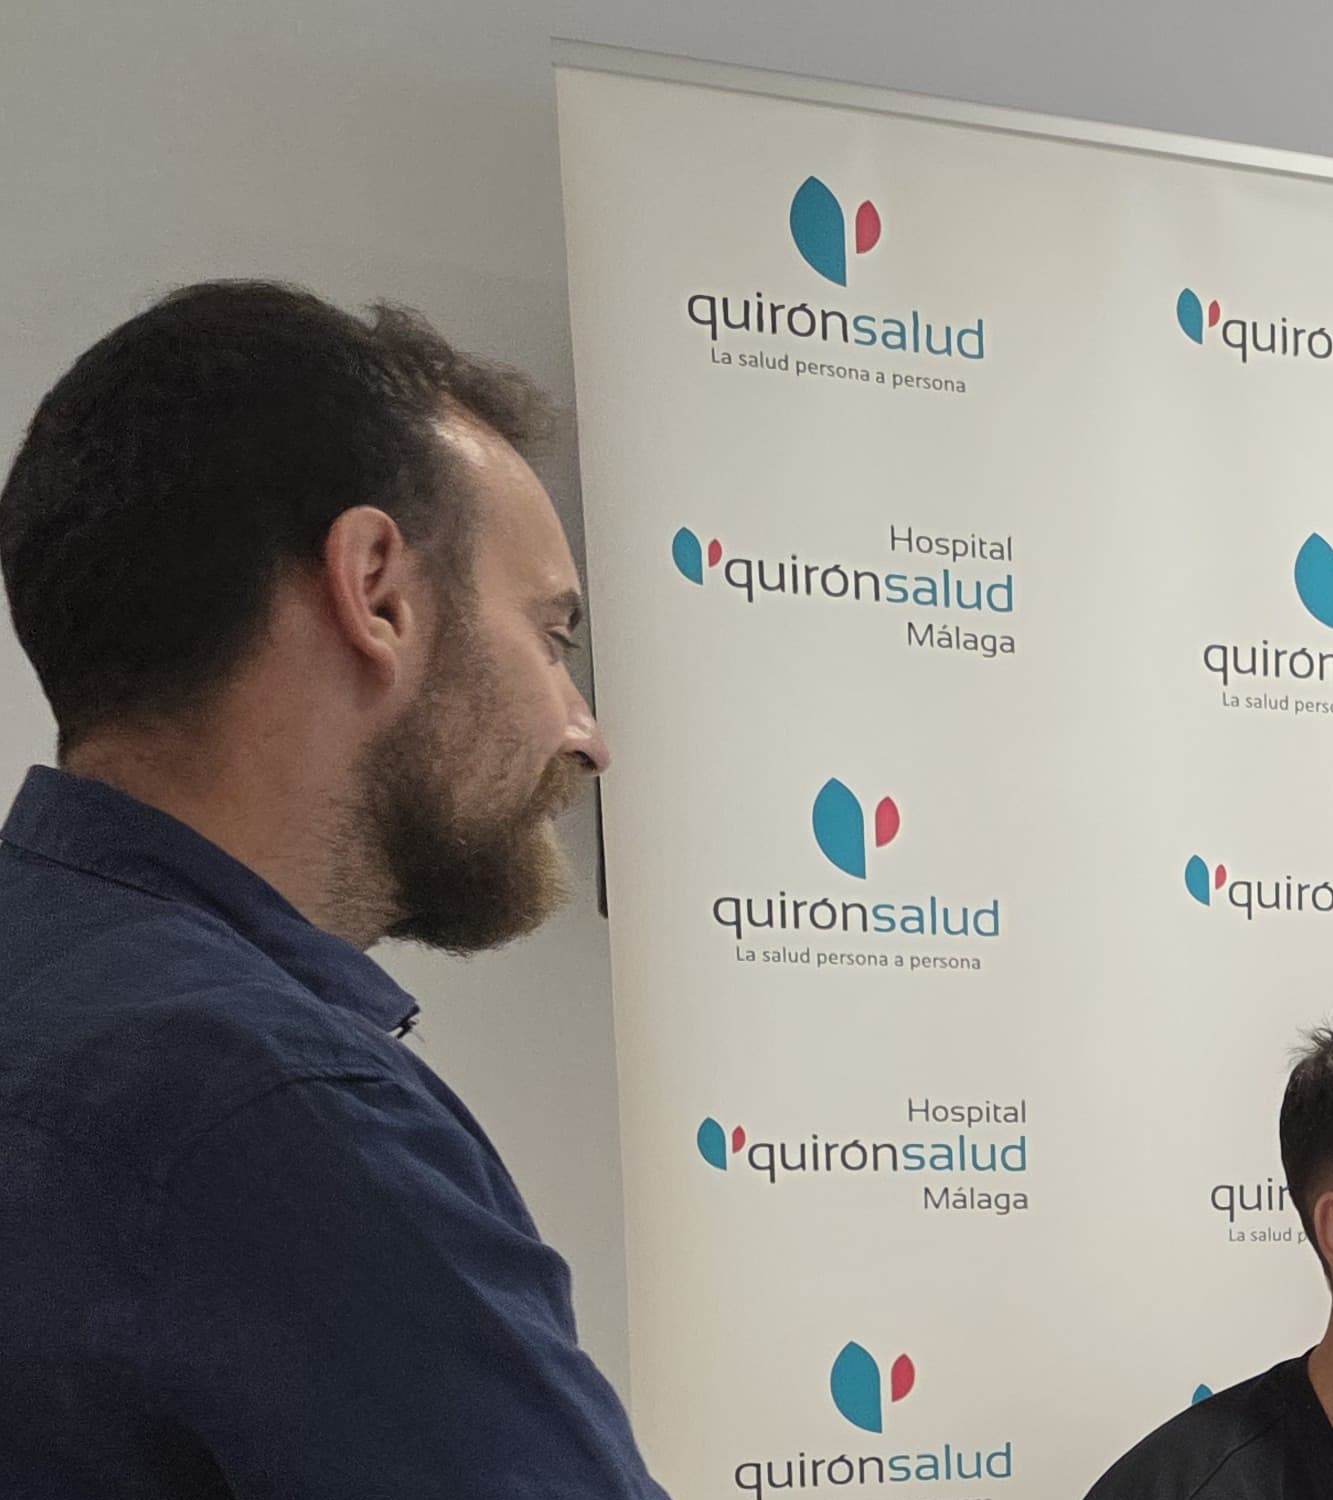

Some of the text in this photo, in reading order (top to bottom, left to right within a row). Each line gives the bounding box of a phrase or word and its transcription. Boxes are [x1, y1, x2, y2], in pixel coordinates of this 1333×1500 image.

[688, 291, 984, 361] quirónsalud
[712, 347, 965, 393] La salud persona a persona
[891, 525, 1011, 562] Hospital
[725, 551, 1013, 612] quirónsalud
[908, 622, 1015, 658] Málaga
[1223, 692, 1239, 707] La
[1246, 693, 1288, 710] salud
[713, 891, 999, 940] quirónsalud
[736, 946, 980, 971] La salud persona a persona
[908, 1098, 1026, 1128] Hospital
[748, 1134, 1026, 1184] quirónsalud
[924, 1187, 1028, 1215] Málaga
[1229, 1229, 1245, 1242] La
[1250, 1227, 1292, 1242] salud
